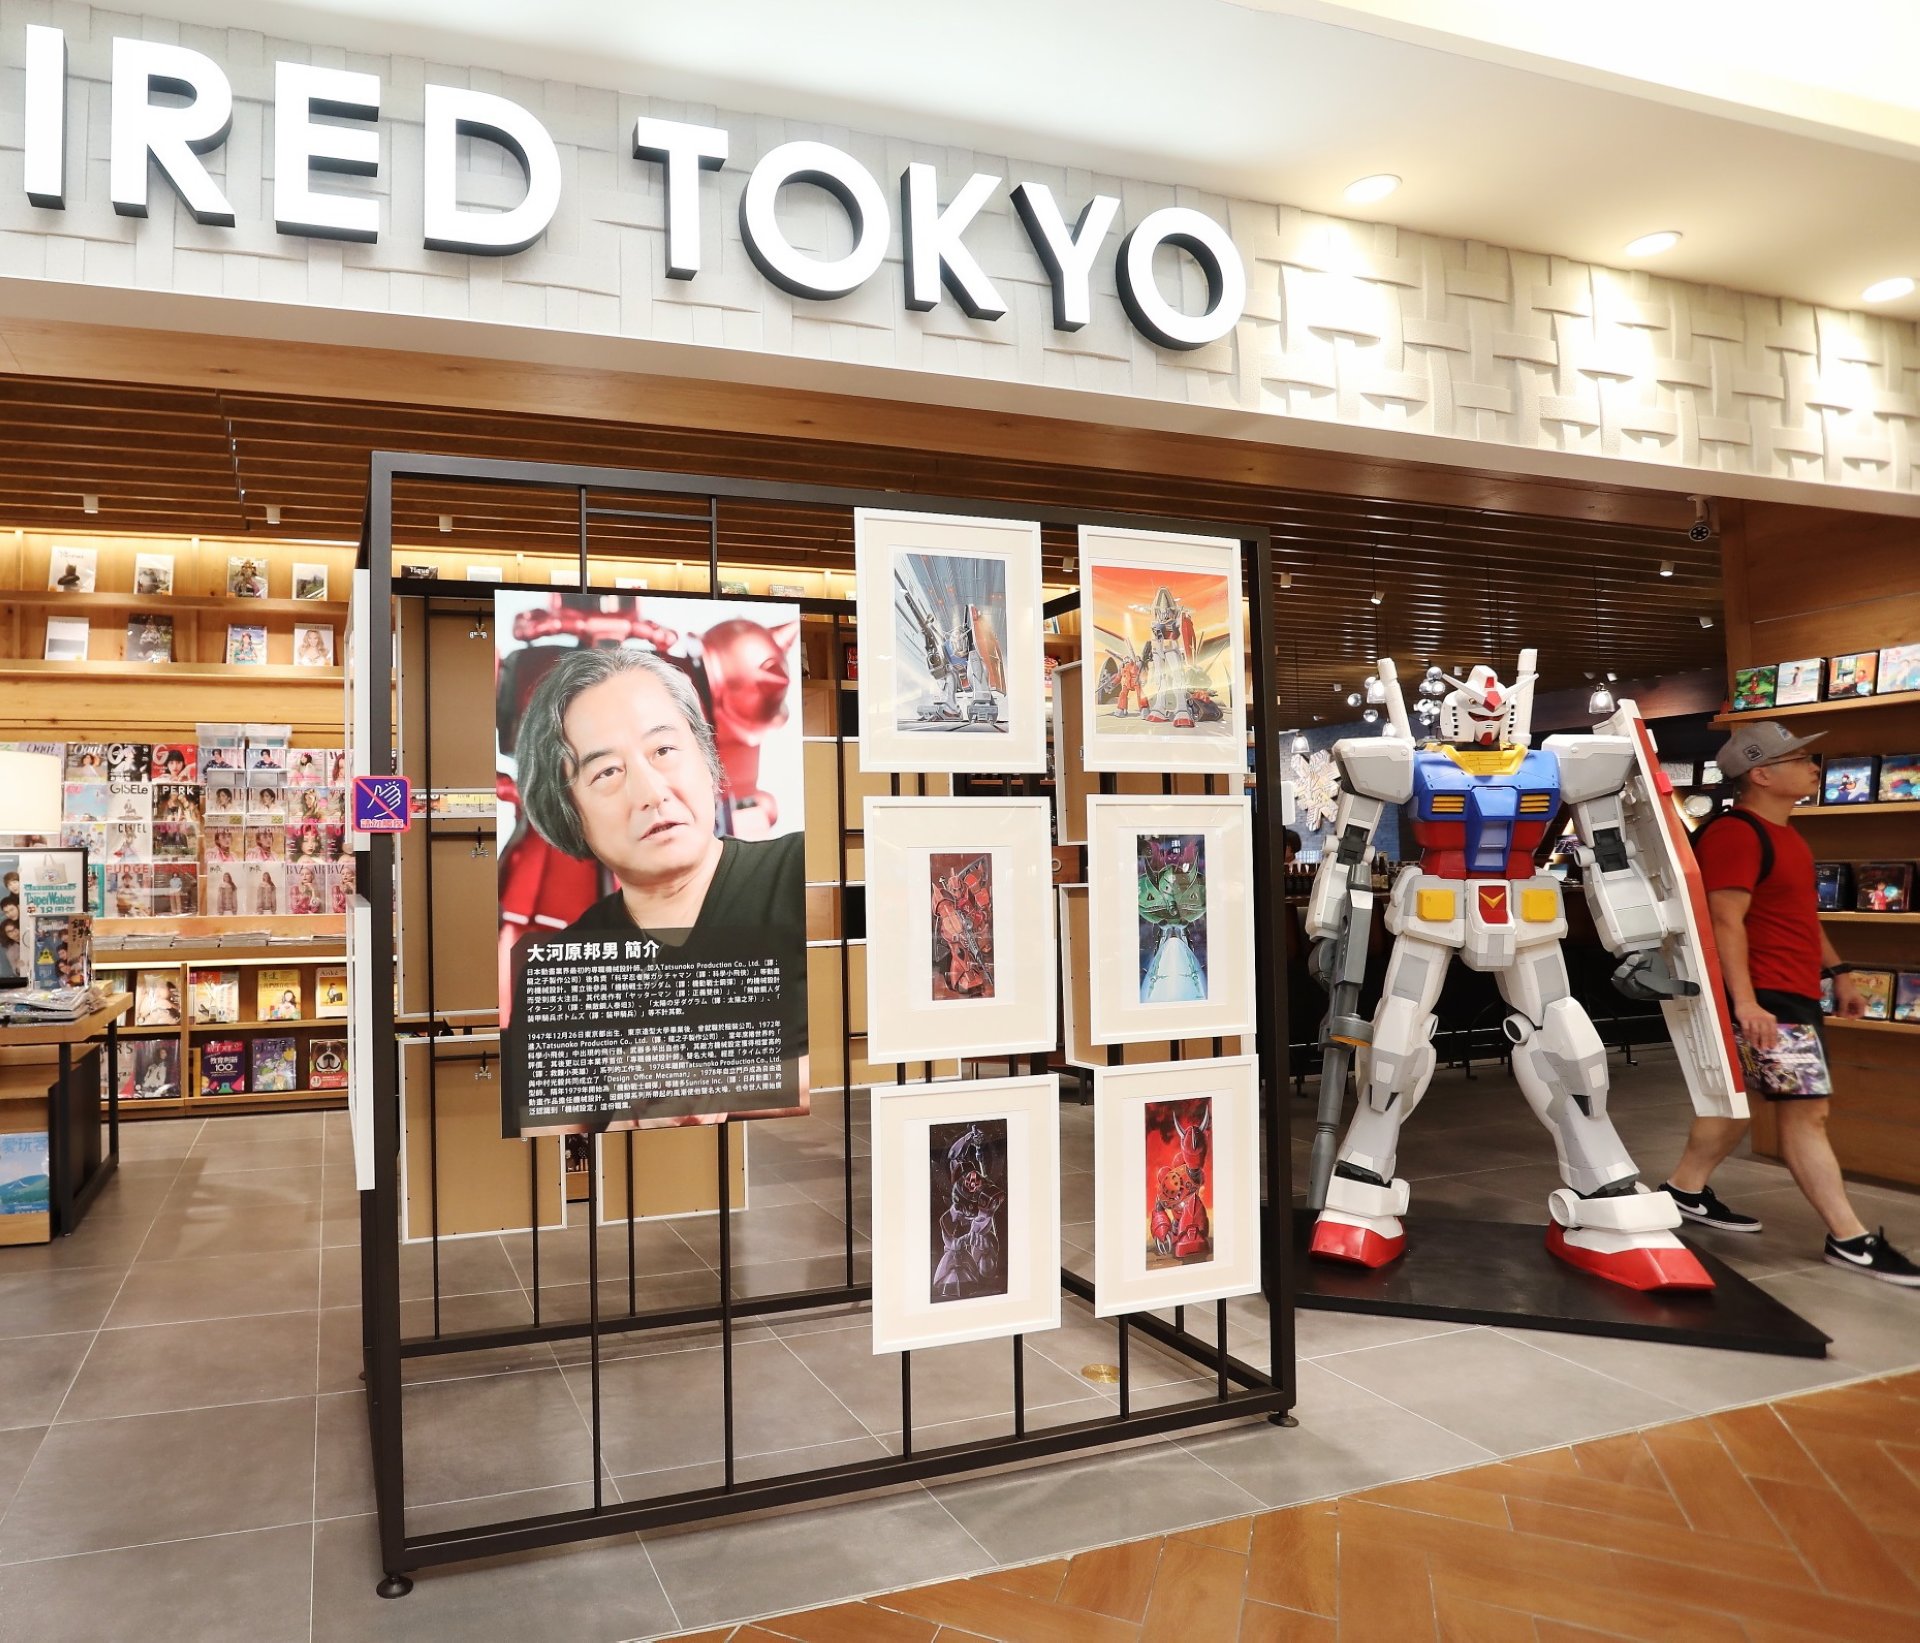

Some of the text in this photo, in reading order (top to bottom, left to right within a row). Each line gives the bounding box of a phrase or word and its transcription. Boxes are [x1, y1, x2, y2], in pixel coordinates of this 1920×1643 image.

[24, 24, 1247, 351] IRED TOKYO
[162, 785, 195, 795] PERK
[106, 864, 149, 874] FUDGE
[527, 940, 660, 963] 大河原邦男 簡介
[696, 961, 733, 970] Production
[580, 1038, 618, 1049] Production
[719, 1057, 755, 1066] Production
[769, 1055, 782, 1063] Ltd.
[215, 1064, 234, 1072] 100
[633, 1073, 653, 1081] Office
